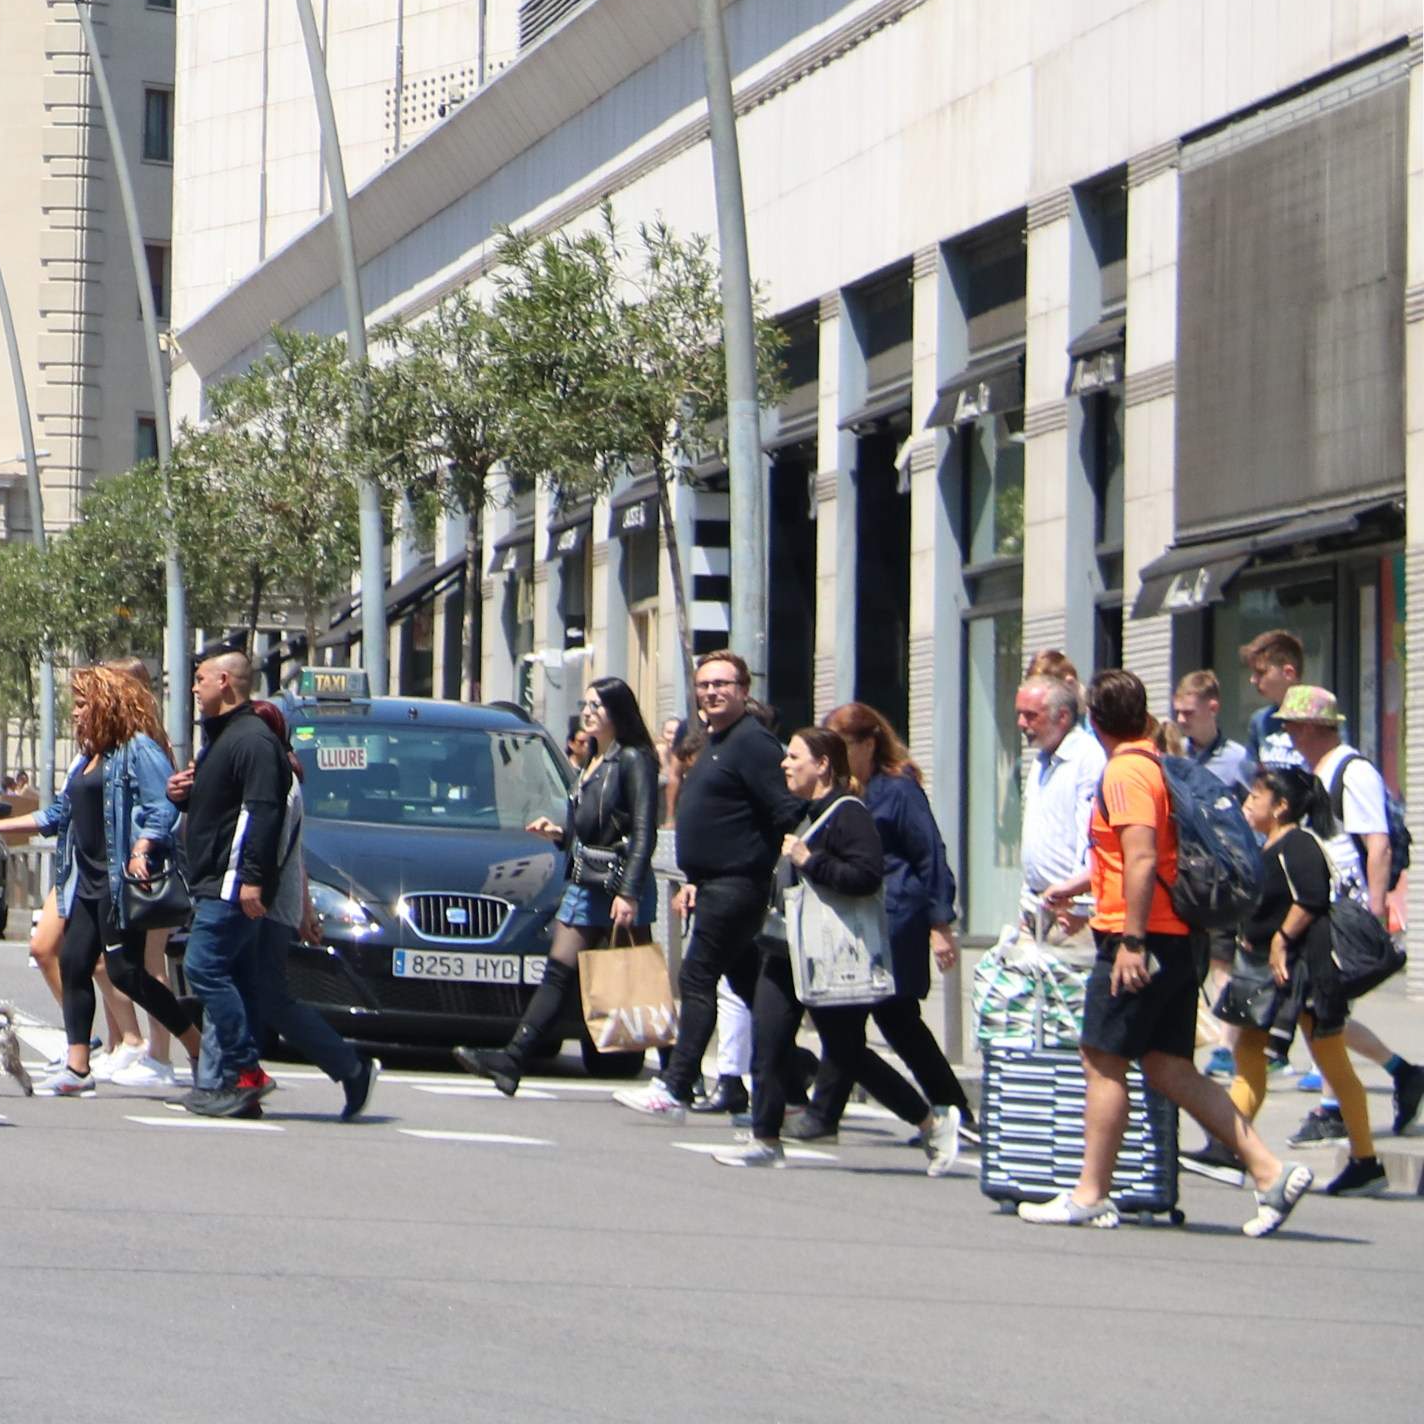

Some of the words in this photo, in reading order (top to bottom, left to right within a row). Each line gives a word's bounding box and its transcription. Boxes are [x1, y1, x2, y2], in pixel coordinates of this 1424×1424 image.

[314, 673, 347, 692] TAXI
[320, 748, 365, 768] LLIURE
[412, 955, 464, 977] 8253
[475, 958, 515, 980] HYD
